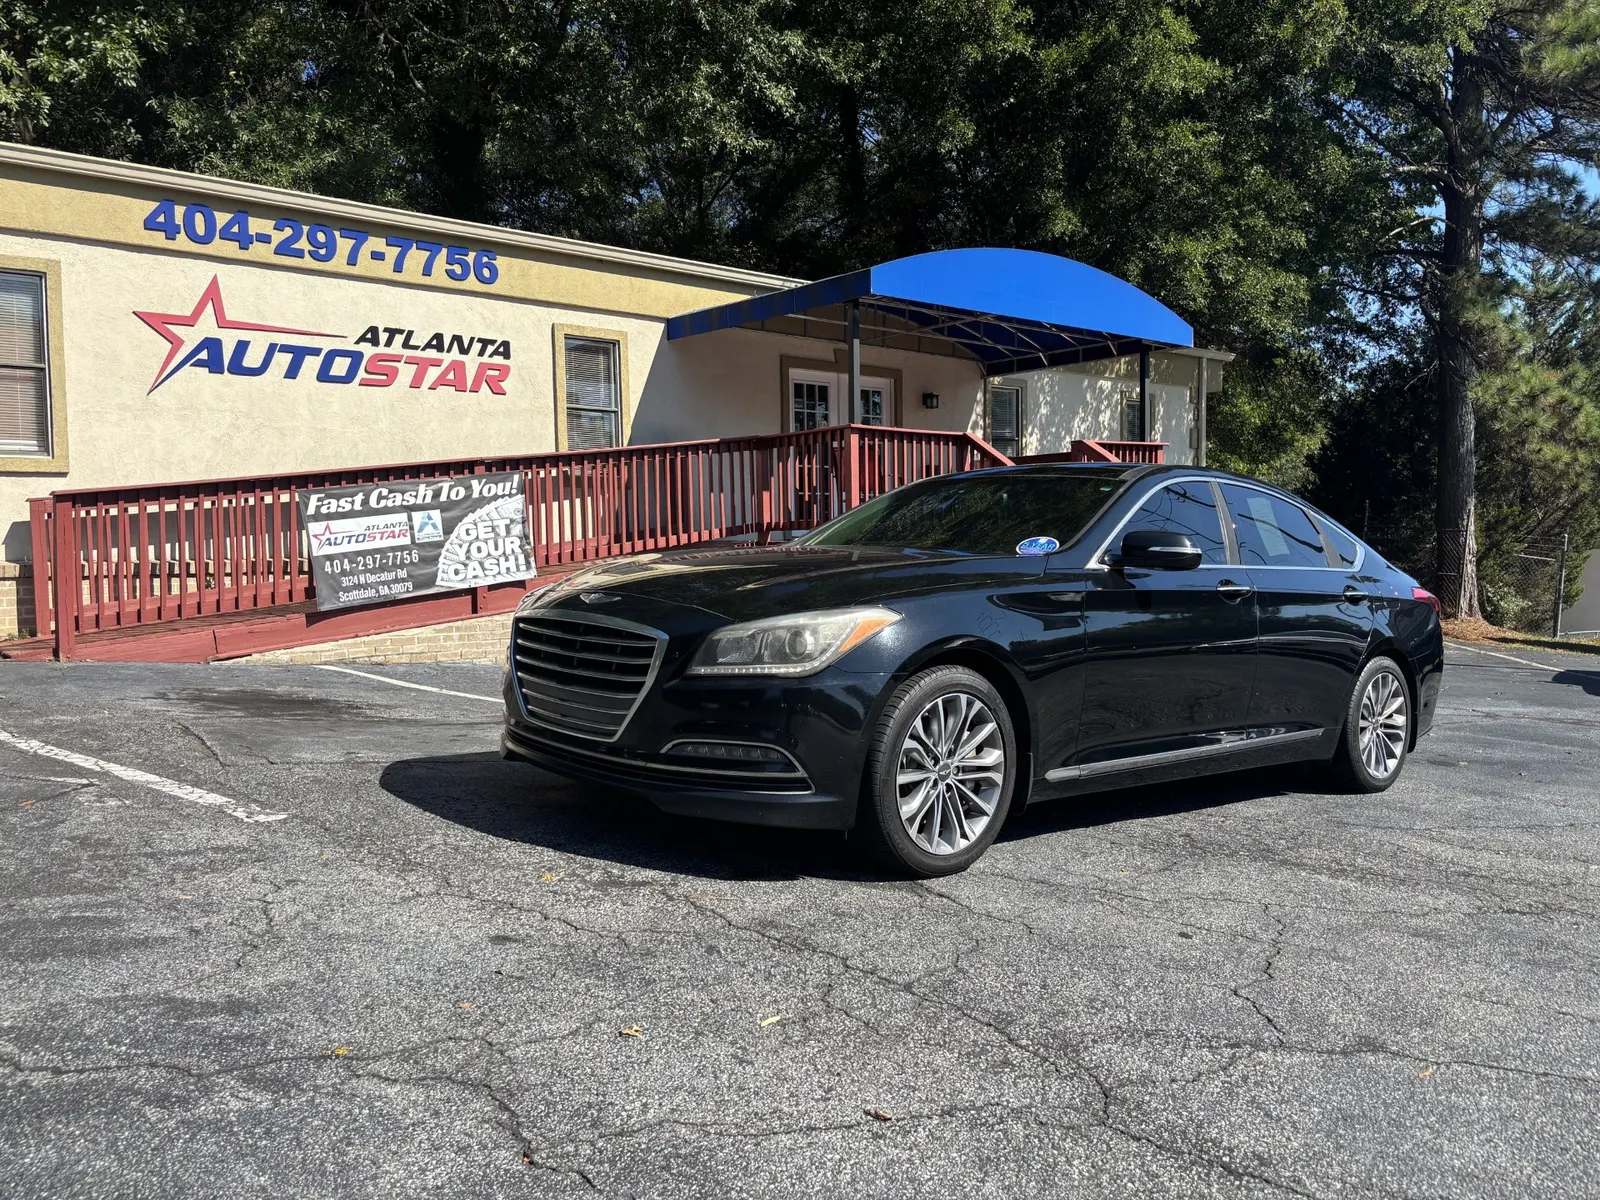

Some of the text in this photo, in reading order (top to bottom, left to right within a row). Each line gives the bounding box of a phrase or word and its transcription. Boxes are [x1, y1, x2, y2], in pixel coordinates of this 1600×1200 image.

[143, 199, 499, 285] 404-297-7756
[353, 325, 512, 360] ATLANTA
[184, 336, 511, 396] AUTOSTAR
[306, 474, 519, 516] Fast Cash To You!
[321, 528, 409, 548] AUTOSTAR
[364, 521, 409, 532] ATLANTA
[458, 518, 511, 542] GET
[452, 536, 522, 561] YOUR
[1031, 541, 1056, 552] YEAR
[324, 549, 419, 575] 404-297-7756
[447, 553, 527, 582] CASH!
[340, 567, 408, 587] 3124 N Decatur Rd
[339, 581, 413, 602] Scottdale, GA 30079
